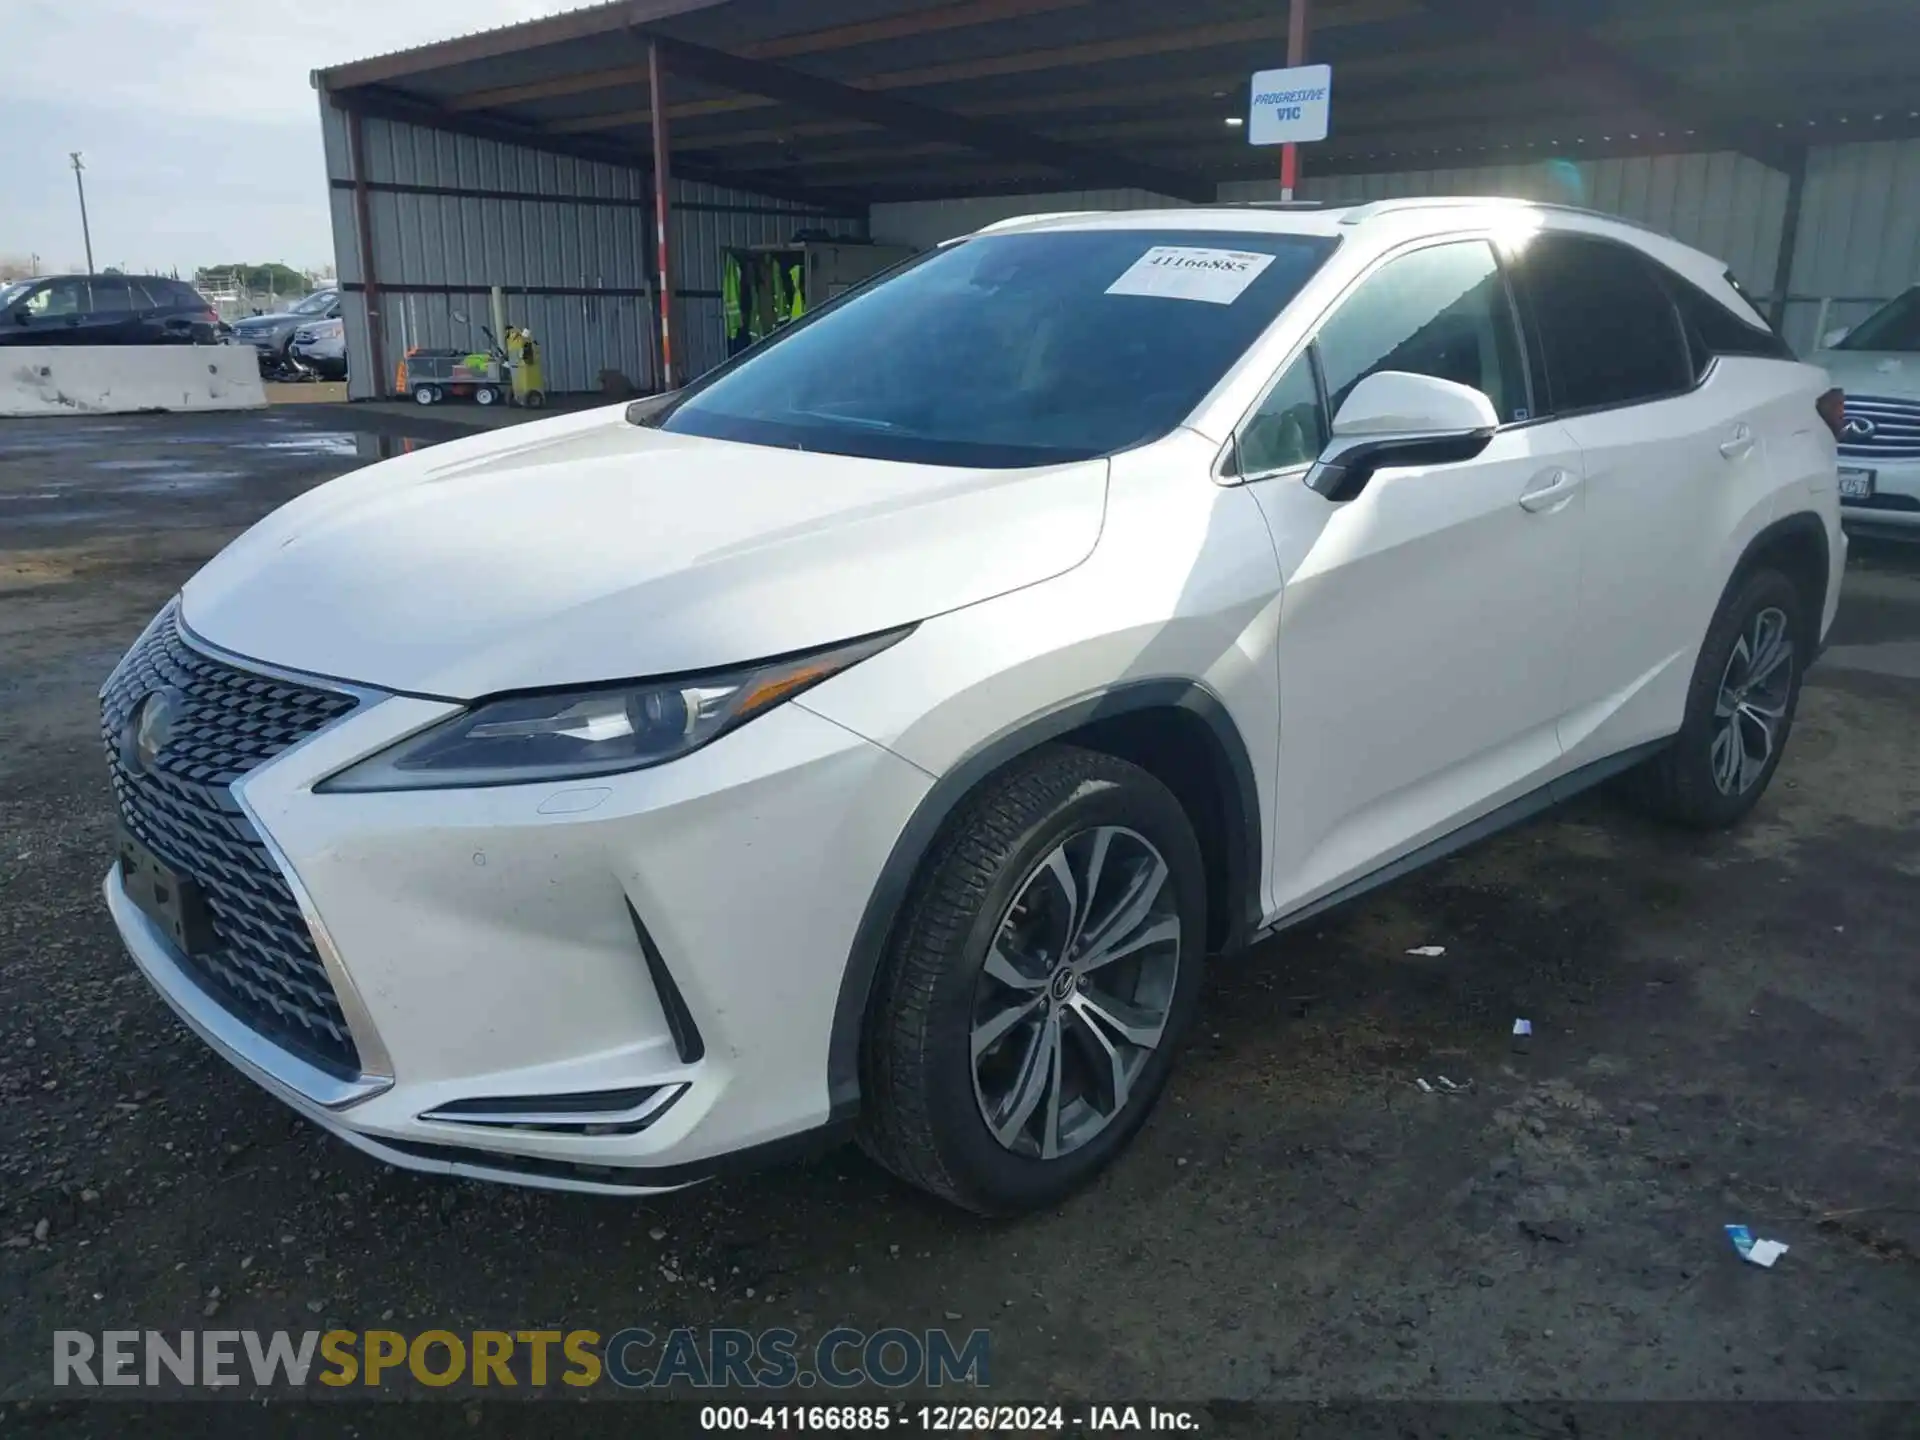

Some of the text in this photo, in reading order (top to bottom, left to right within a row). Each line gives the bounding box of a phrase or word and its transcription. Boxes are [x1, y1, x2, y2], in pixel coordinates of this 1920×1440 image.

[1254, 87, 1326, 105] PROGRESSIVE
[1277, 107, 1301, 121] VIC
[1150, 254, 1250, 272] 41166885
